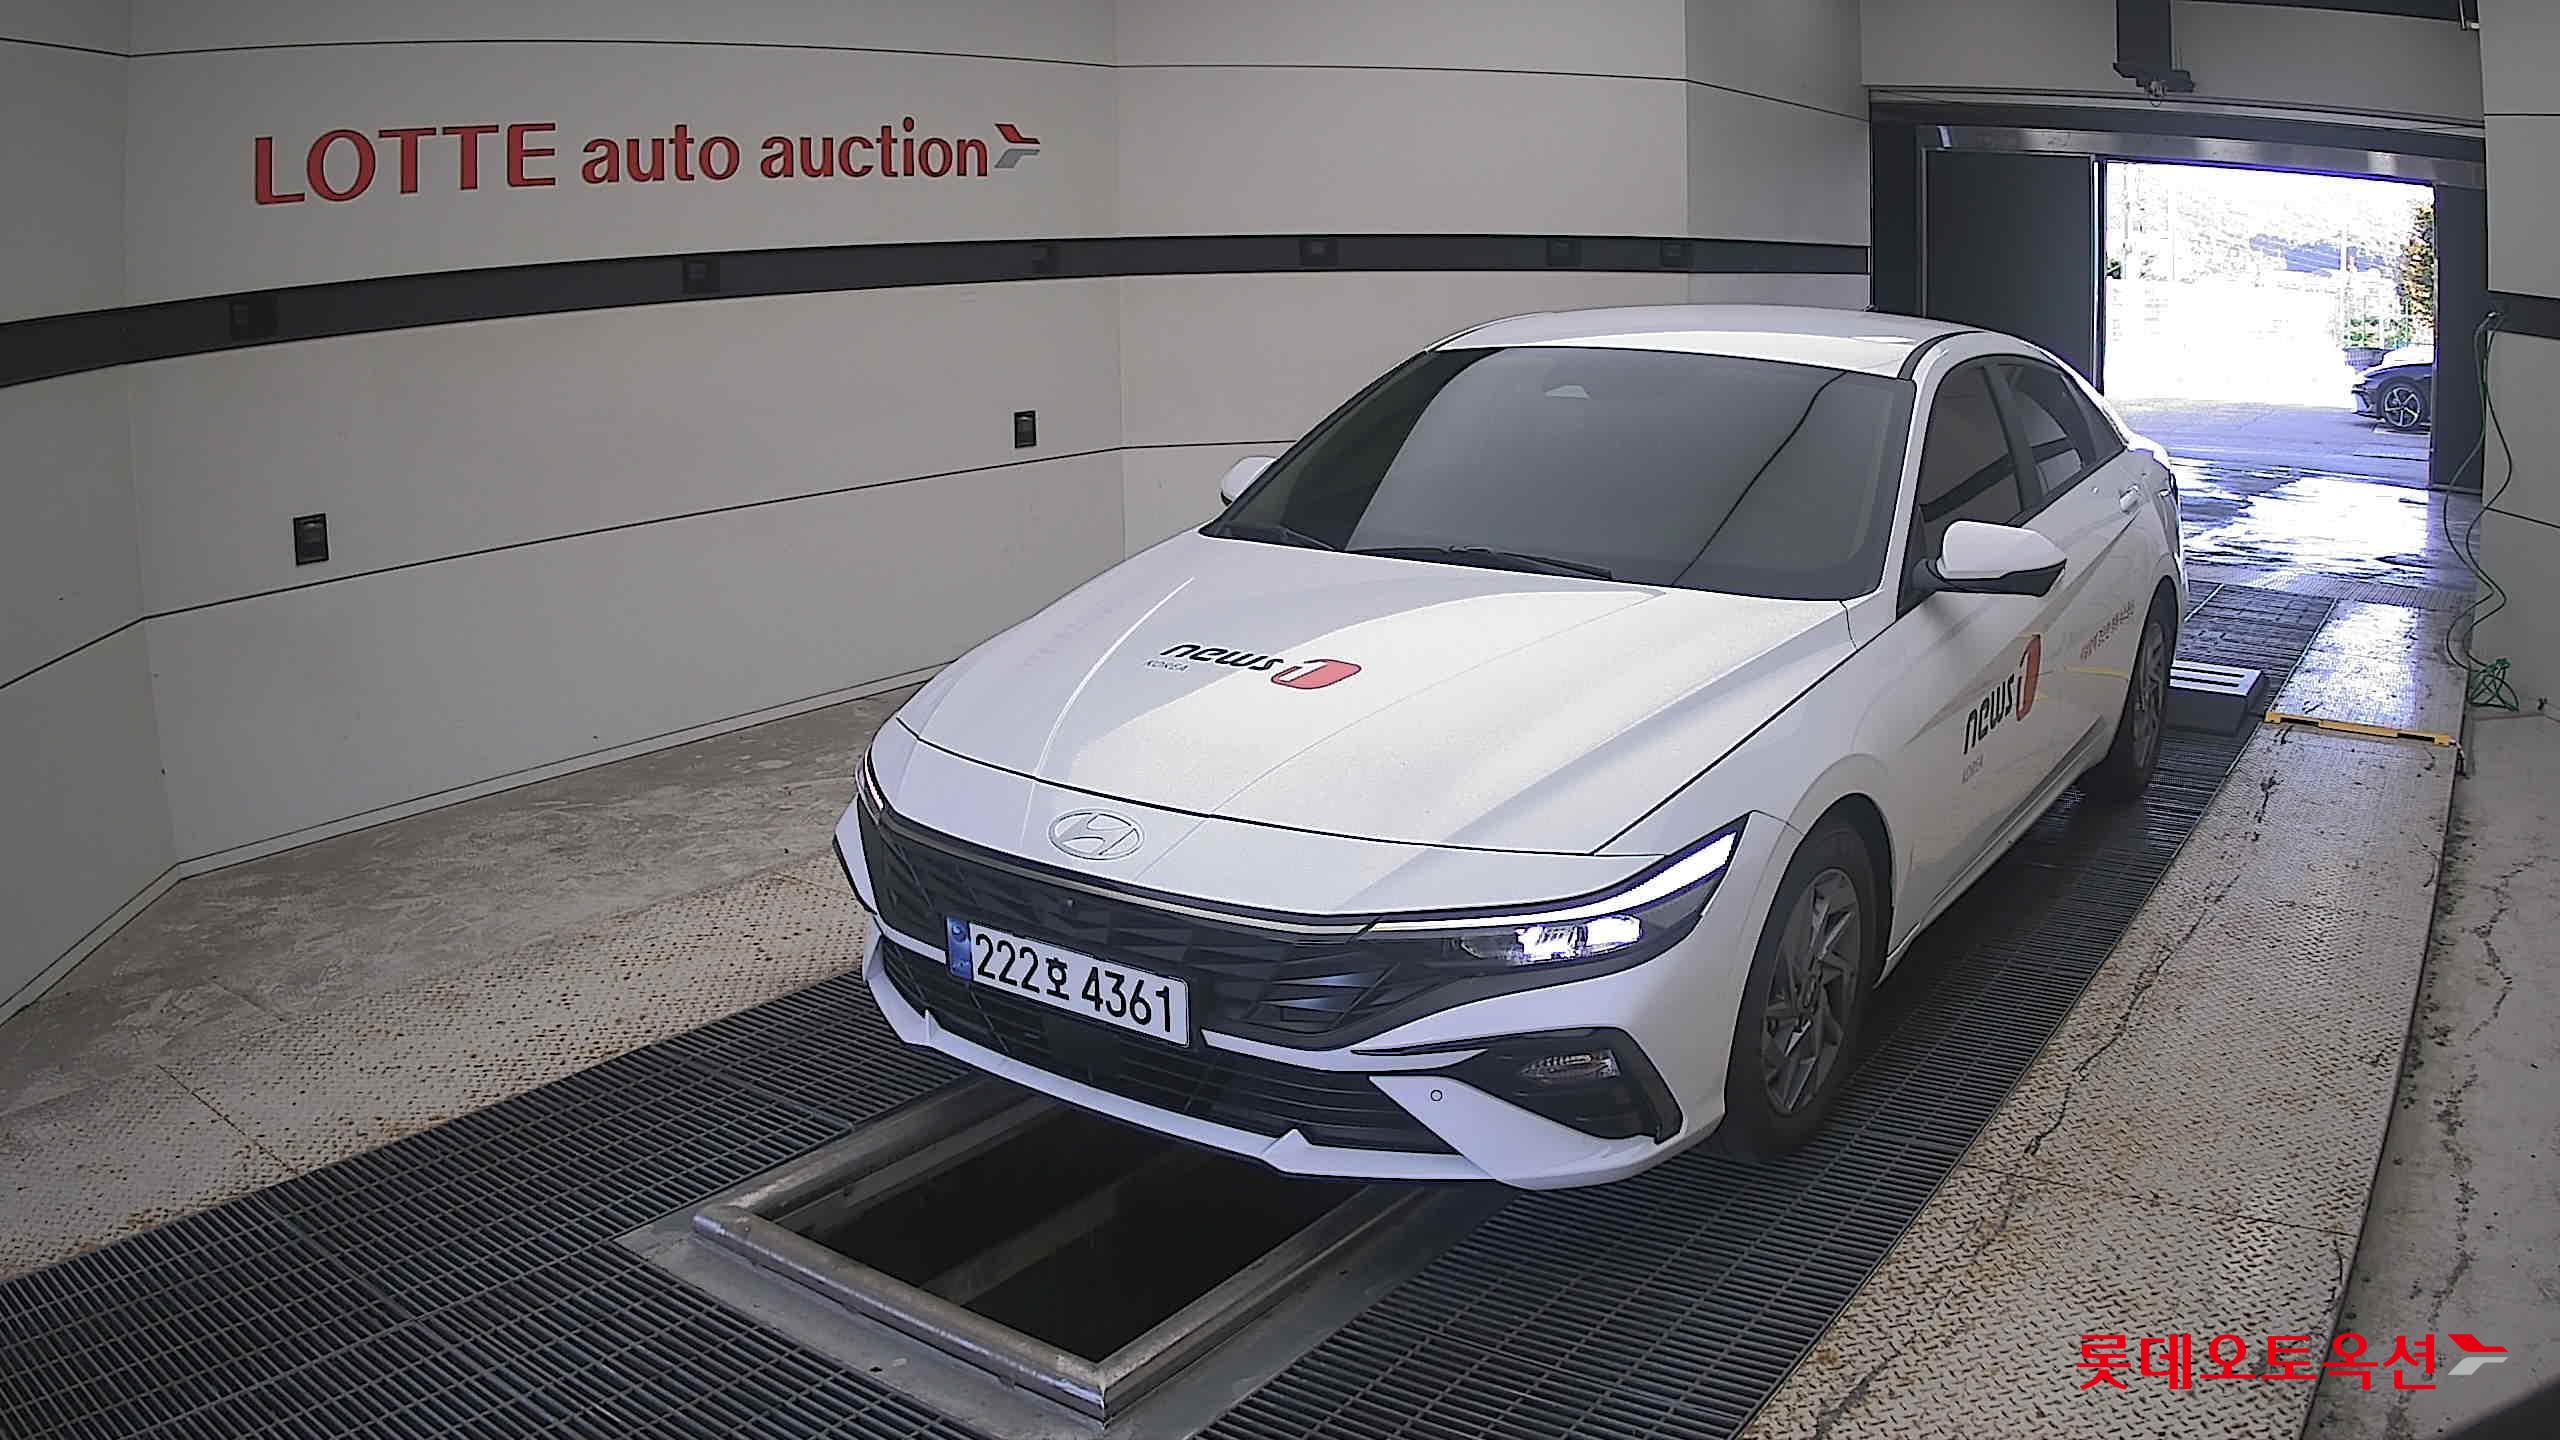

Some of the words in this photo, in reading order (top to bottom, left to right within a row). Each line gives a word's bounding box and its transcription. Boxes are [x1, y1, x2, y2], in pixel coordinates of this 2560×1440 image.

[253, 122, 557, 206] LOTTE
[580, 123, 742, 184] auto
[759, 115, 990, 179] auction
[975, 933, 1070, 1001] 222호
[1081, 966, 1172, 1033] 4361
